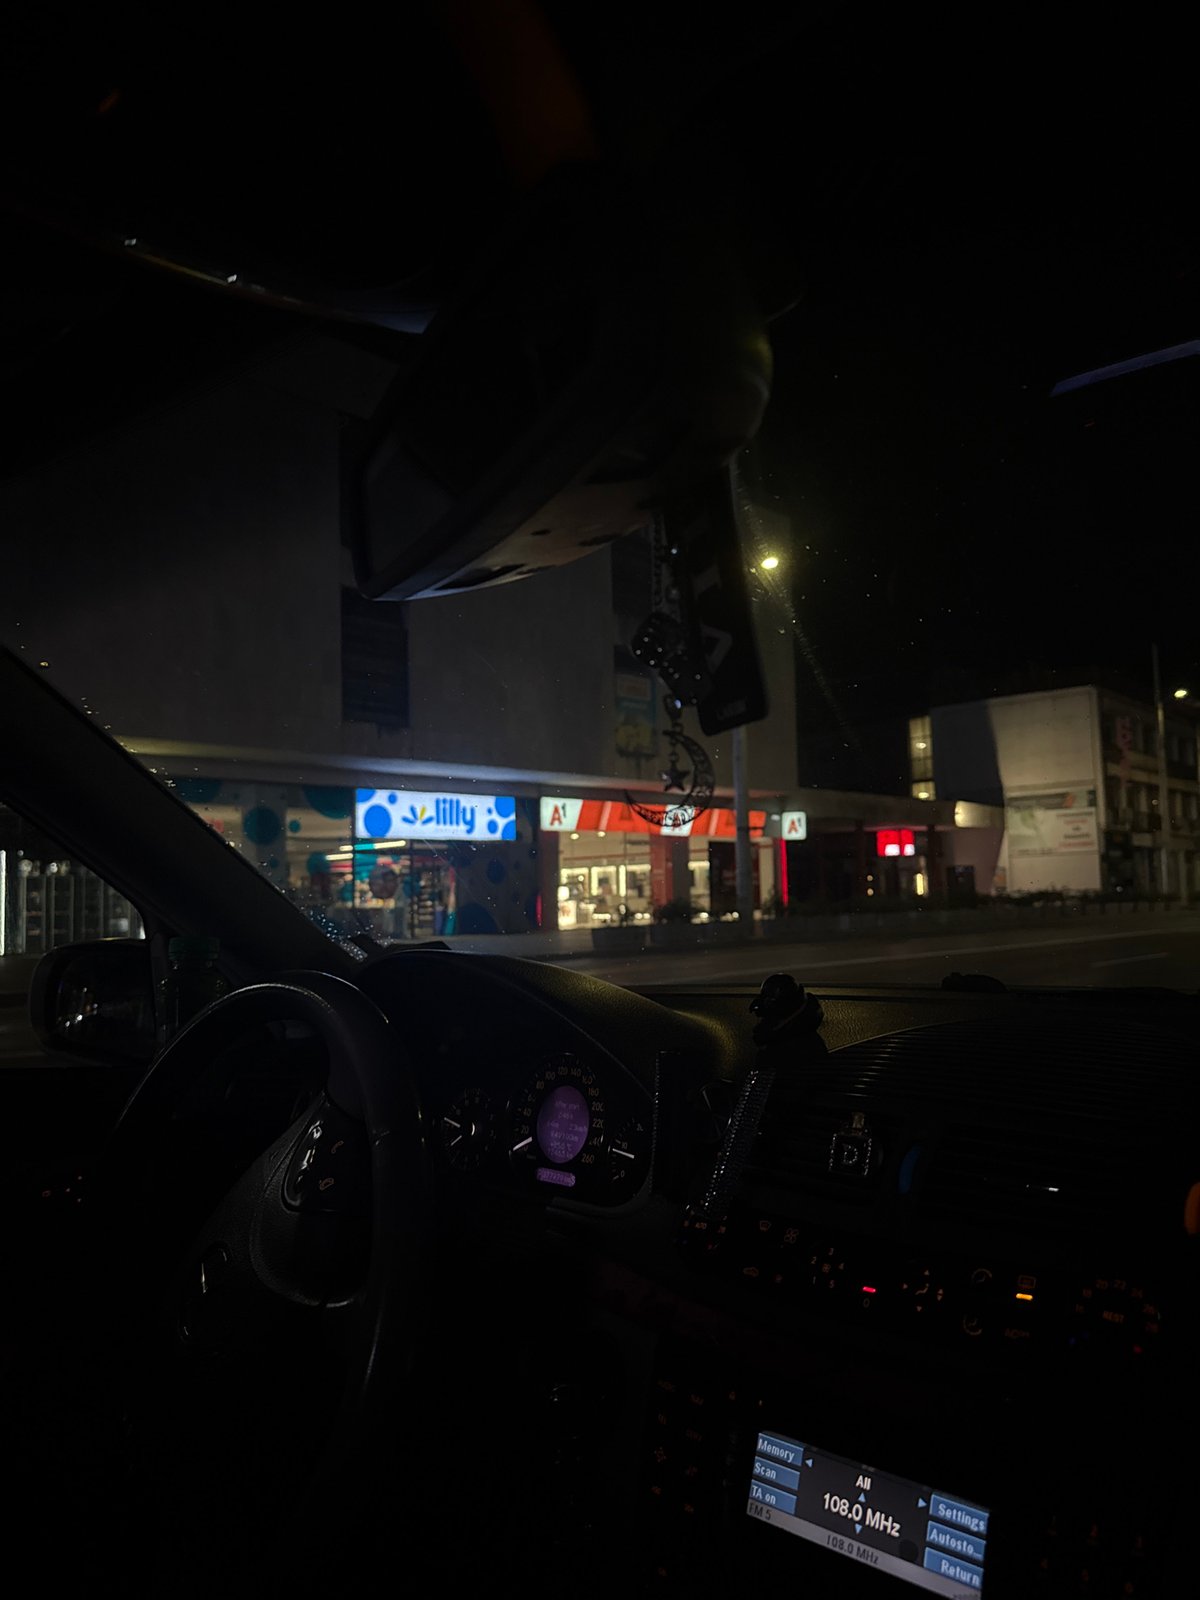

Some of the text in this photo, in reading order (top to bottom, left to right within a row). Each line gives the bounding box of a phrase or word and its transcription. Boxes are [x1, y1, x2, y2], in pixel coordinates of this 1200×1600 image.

[435, 797, 476, 834] lilly
[549, 802, 567, 826] A1
[757, 1438, 796, 1463] Memory
[754, 1462, 777, 1480] Scan
[855, 1474, 872, 1491] All
[752, 1485, 777, 1505] TA on
[749, 1501, 772, 1521] FM 5
[823, 1492, 901, 1537] 108.0 MHz
[937, 1502, 986, 1532] Settings
[826, 1534, 880, 1565] 108.0 MHz
[940, 1557, 981, 1588] Return
